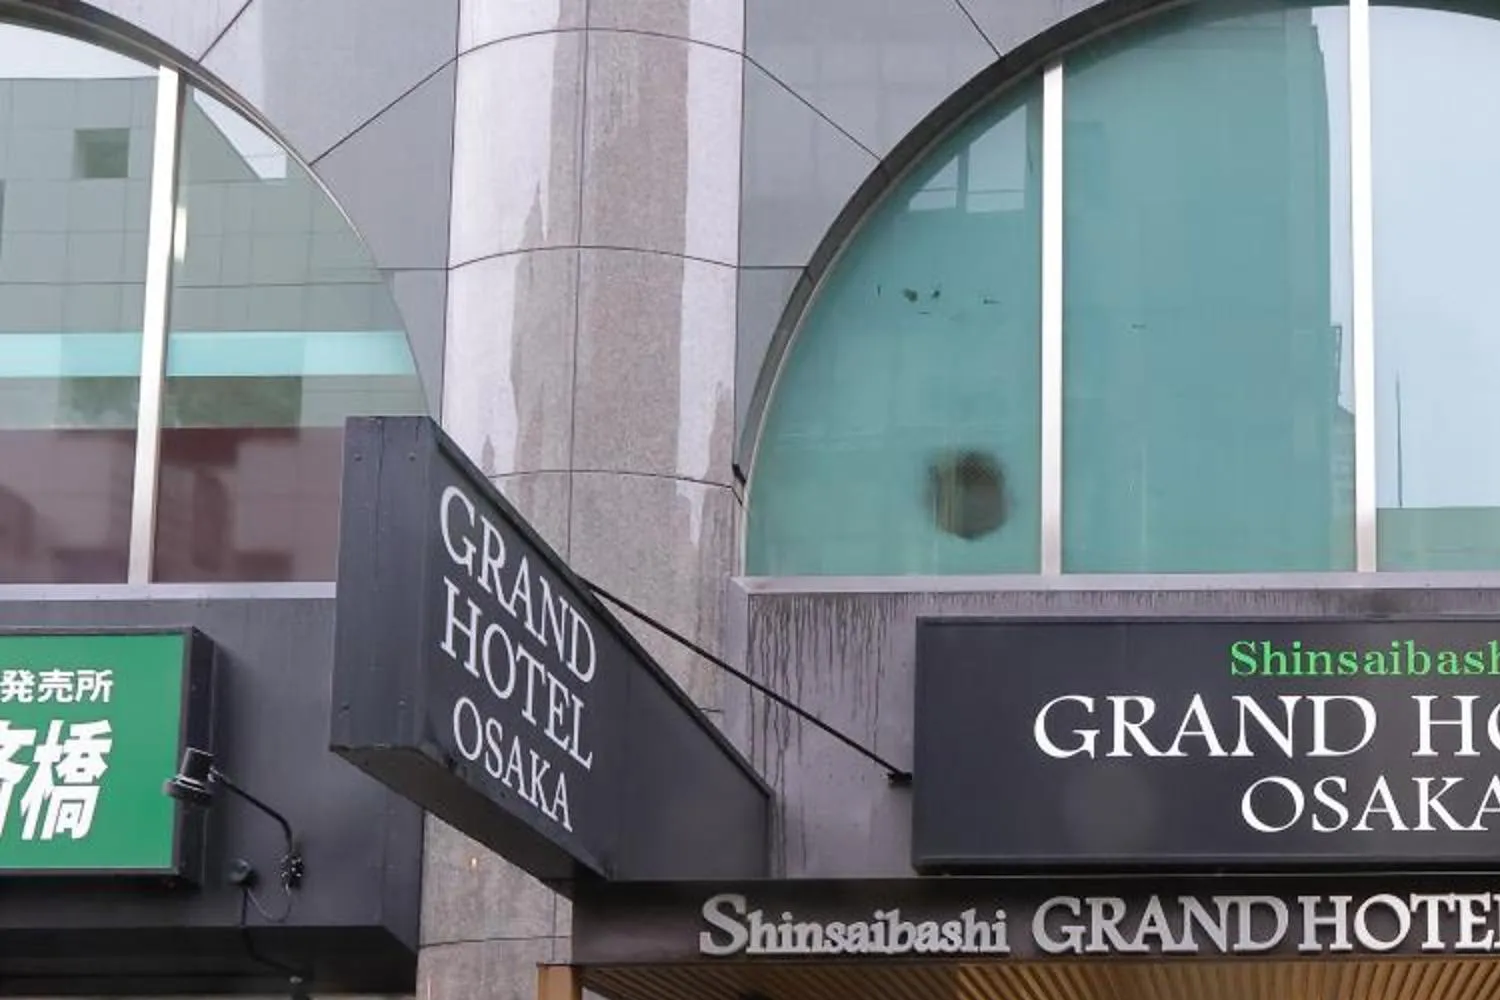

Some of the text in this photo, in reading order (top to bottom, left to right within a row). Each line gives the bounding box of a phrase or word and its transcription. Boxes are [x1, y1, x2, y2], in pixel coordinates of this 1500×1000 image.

[440, 486, 597, 684] GRAND
[0, 669, 114, 703] 発売所
[440, 576, 593, 771] HOTEL
[452, 696, 574, 833] OSAKA
[1033, 693, 1377, 759] GRAND
[698, 893, 1010, 957] Shinsaibashi
[1030, 894, 1290, 956] GRAND
